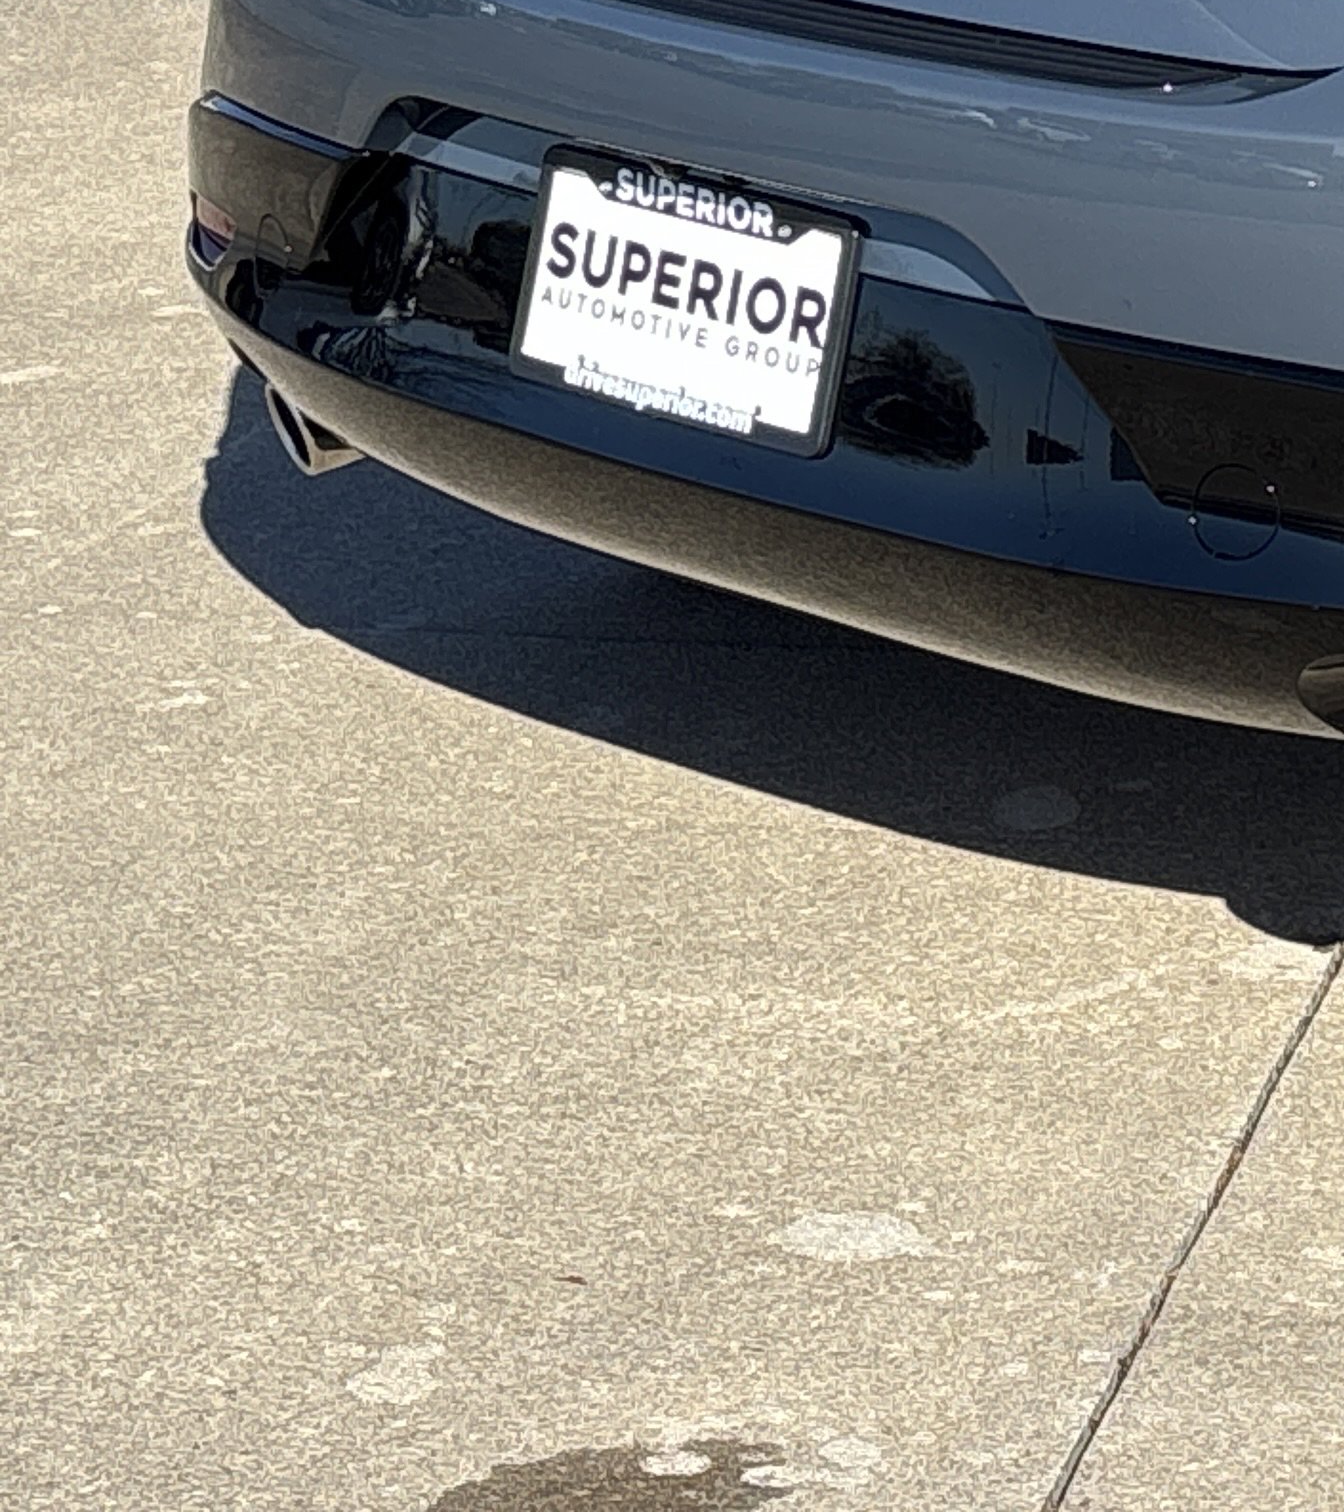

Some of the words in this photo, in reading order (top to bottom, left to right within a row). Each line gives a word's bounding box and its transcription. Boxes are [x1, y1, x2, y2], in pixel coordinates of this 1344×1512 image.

[615, 168, 774, 238] SUPERIOR
[545, 222, 827, 349] SUPERIOR
[540, 286, 709, 349] AUTOMOTIVE
[725, 335, 822, 377] GROUP
